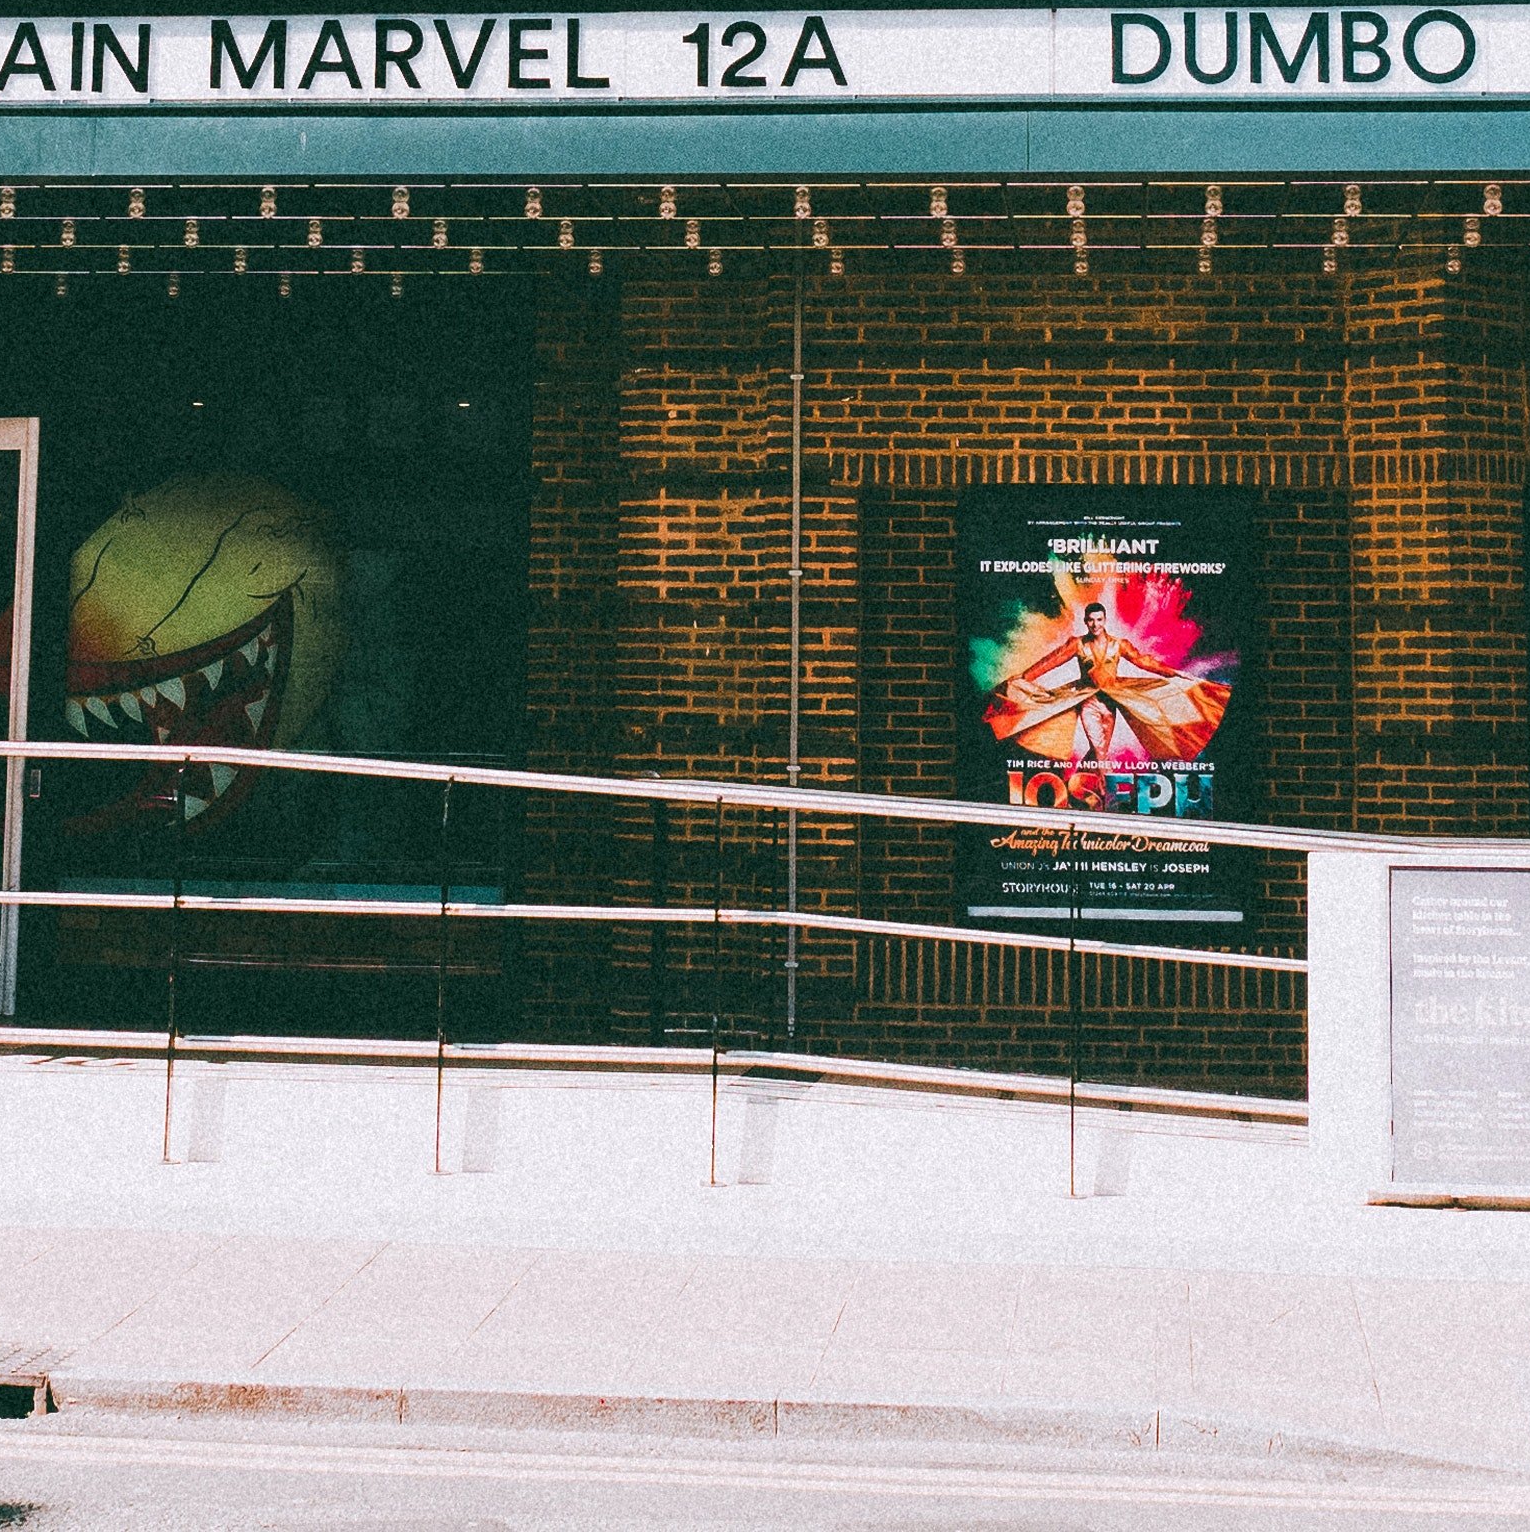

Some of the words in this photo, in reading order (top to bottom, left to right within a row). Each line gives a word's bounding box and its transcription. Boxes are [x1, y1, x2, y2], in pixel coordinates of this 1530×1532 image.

[210, 18, 611, 91] MARVEL
[681, 14, 849, 89] 12A
[1110, 9, 1478, 86] DUMBO
[980, 560, 992, 572] IT
[993, 560, 1054, 573] EXPLODES
[1083, 561, 1151, 574] GLITTERING
[1006, 759, 1025, 769] TIM
[1026, 759, 1051, 769] RICE
[1053, 761, 1073, 769] AND
[1075, 760, 1125, 770] ANDREW
[1125, 760, 1159, 771] LLOYD
[1006, 770, 1214, 818] JOSEPH
[989, 830, 1060, 857] Amazing
[1000, 861, 1035, 871] UNION
[1091, 861, 1148, 872] HENSLEY
[1161, 863, 1210, 873] JOSEPH
[1001, 882, 1079, 895] STORYHOU
[1089, 881, 1105, 890] TUE
[1125, 882, 1141, 890] SAT
[1157, 883, 1176, 891] APR
